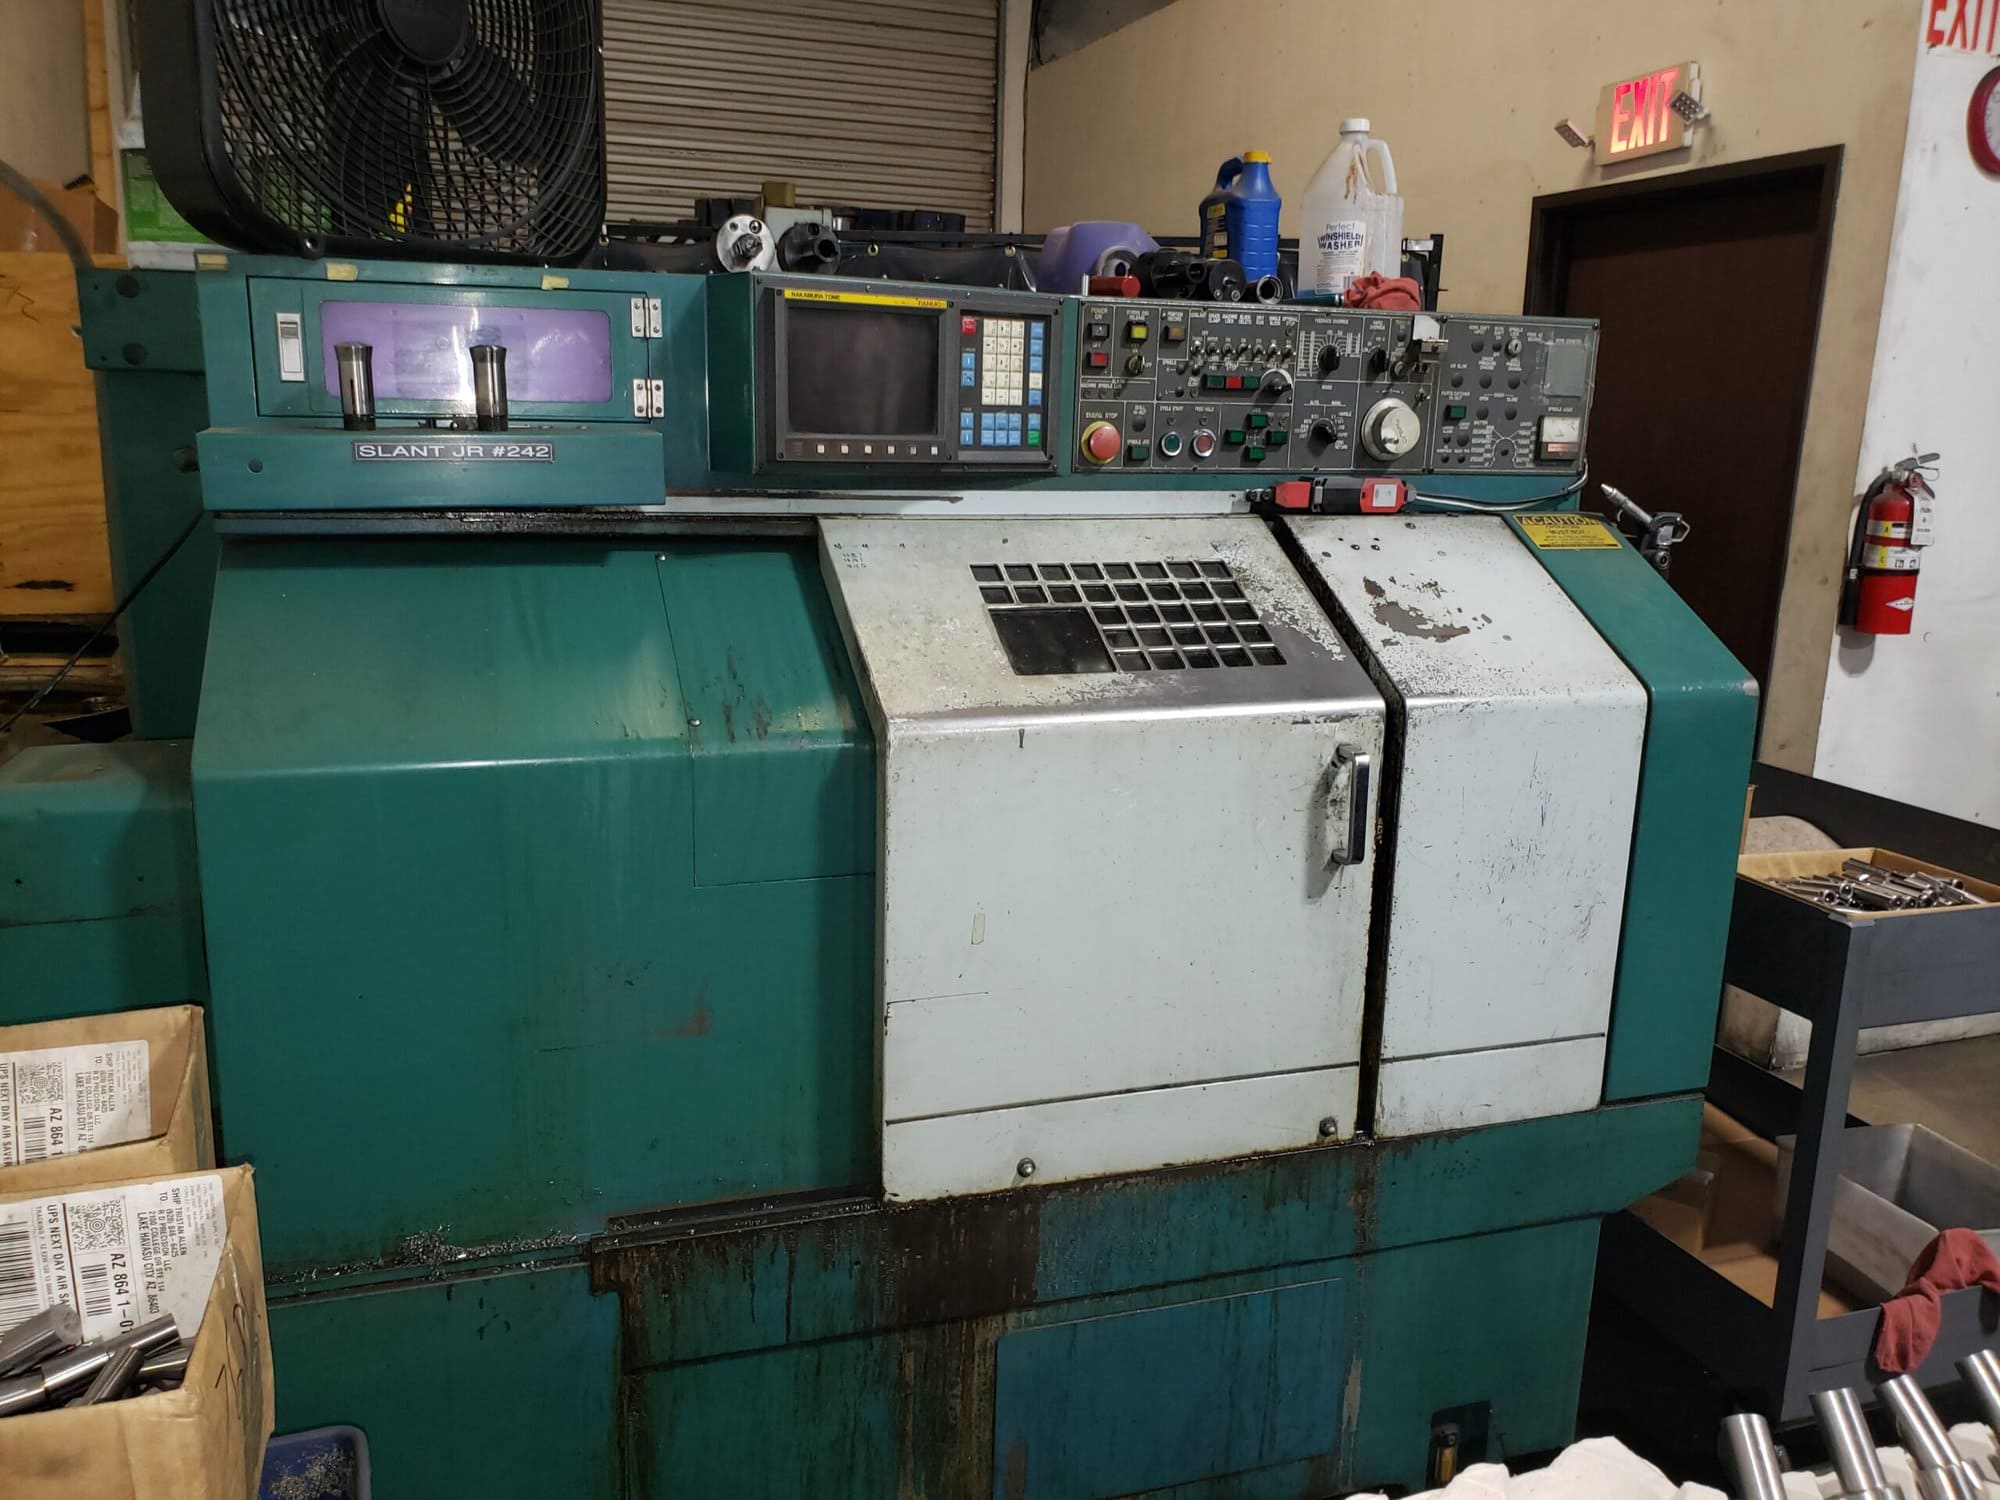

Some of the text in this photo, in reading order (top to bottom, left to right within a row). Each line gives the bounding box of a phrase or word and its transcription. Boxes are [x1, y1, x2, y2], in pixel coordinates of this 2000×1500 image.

[1610, 65, 1679, 154] EXIT
[1319, 240, 1360, 250] WASHER
[359, 445, 550, 458] SLANT JR #242
[1, 1106, 10, 1122] DAY
[49, 1107, 63, 1122] AZ
[3, 1125, 12, 1139] AIR
[50, 1126, 63, 1146] 864
[46, 1204, 58, 1224] UPS
[137, 1212, 148, 1231] LAKE
[172, 1187, 187, 1256] SHIP TRISTAN ALLEN
[50, 1226, 63, 1250] NEXT
[140, 1232, 154, 1261] HAVASU
[150, 1227, 161, 1254] COLLEGE
[159, 1223, 169, 1256] PRECISION
[53, 1253, 66, 1272] DAY
[110, 1253, 126, 1270] AZ
[144, 1263, 155, 1278] CITY
[163, 1259, 172, 1272] LLC
[56, 1275, 68, 1291] AIR
[113, 1273, 129, 1296] 864
[146, 1281, 156, 1291] AZ
